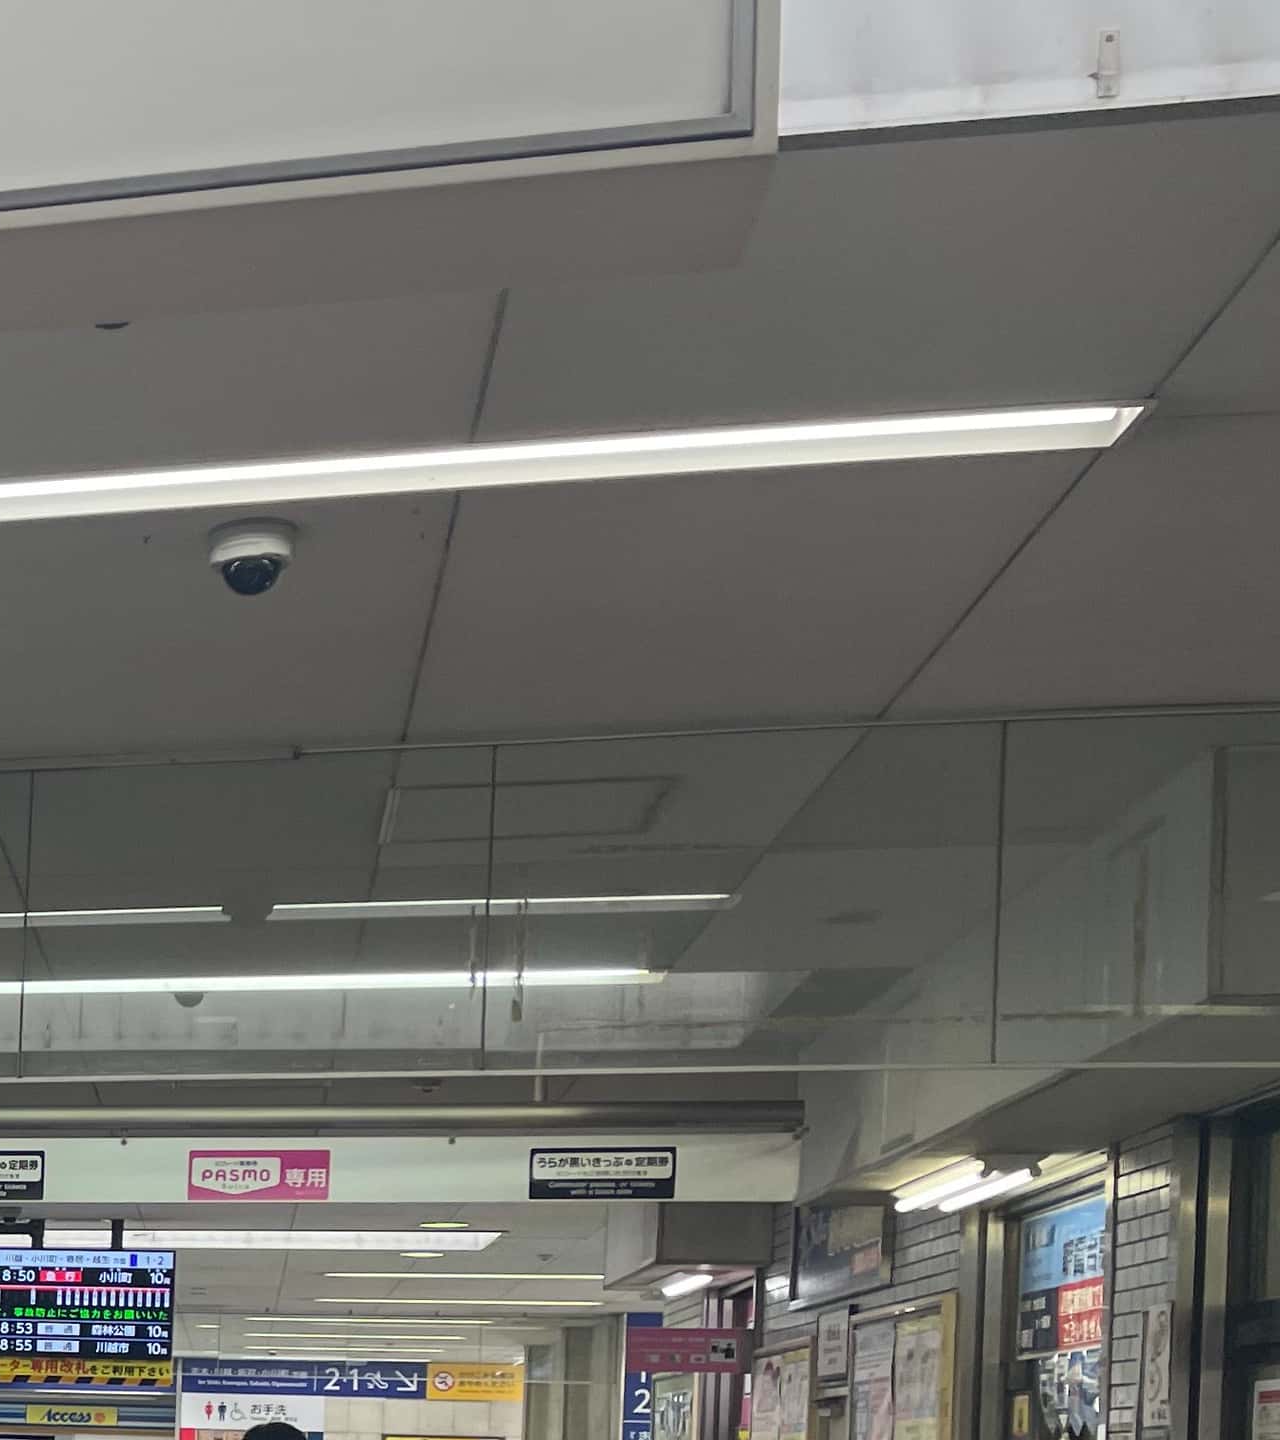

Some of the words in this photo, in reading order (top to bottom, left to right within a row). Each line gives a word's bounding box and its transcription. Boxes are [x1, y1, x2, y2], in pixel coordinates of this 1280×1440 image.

[201, 1169, 271, 1182] PASMO
[285, 1168, 328, 1187] 専用
[2, 1269, 36, 1282] 8:50
[0, 1322, 33, 1334] 8:53
[0, 1339, 33, 1351] 8:55
[633, 1388, 651, 1413] 2
